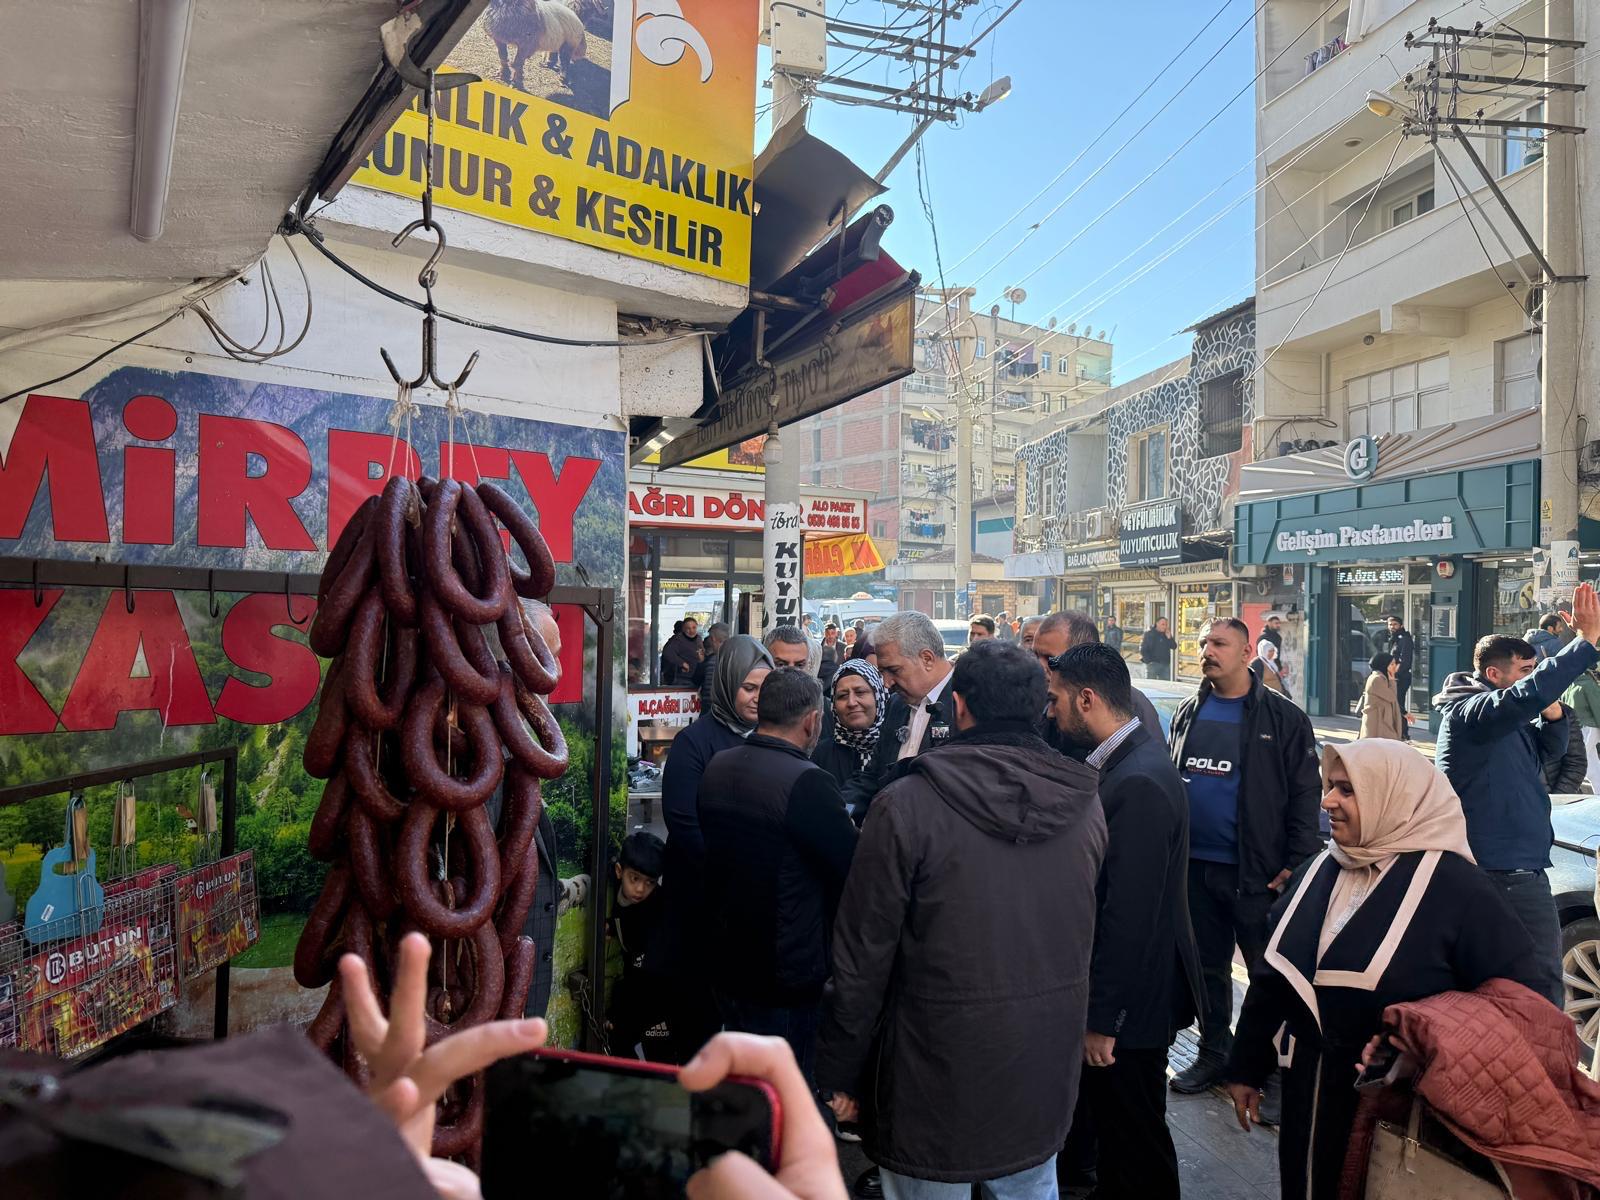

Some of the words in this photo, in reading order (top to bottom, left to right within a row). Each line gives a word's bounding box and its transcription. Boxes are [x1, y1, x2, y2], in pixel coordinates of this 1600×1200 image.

[404, 84, 528, 146] NLIK
[541, 113, 573, 159] &
[587, 128, 752, 215] ADAKLIK
[528, 174, 560, 221] &
[812, 501, 829, 512] ALO
[830, 502, 855, 513] PAKET
[1276, 529, 1339, 556] Gelişim
[1339, 516, 1454, 548] Pastaneleri
[1067, 553, 1087, 567] BAĞLAR
[1185, 757, 1232, 772] POLO
